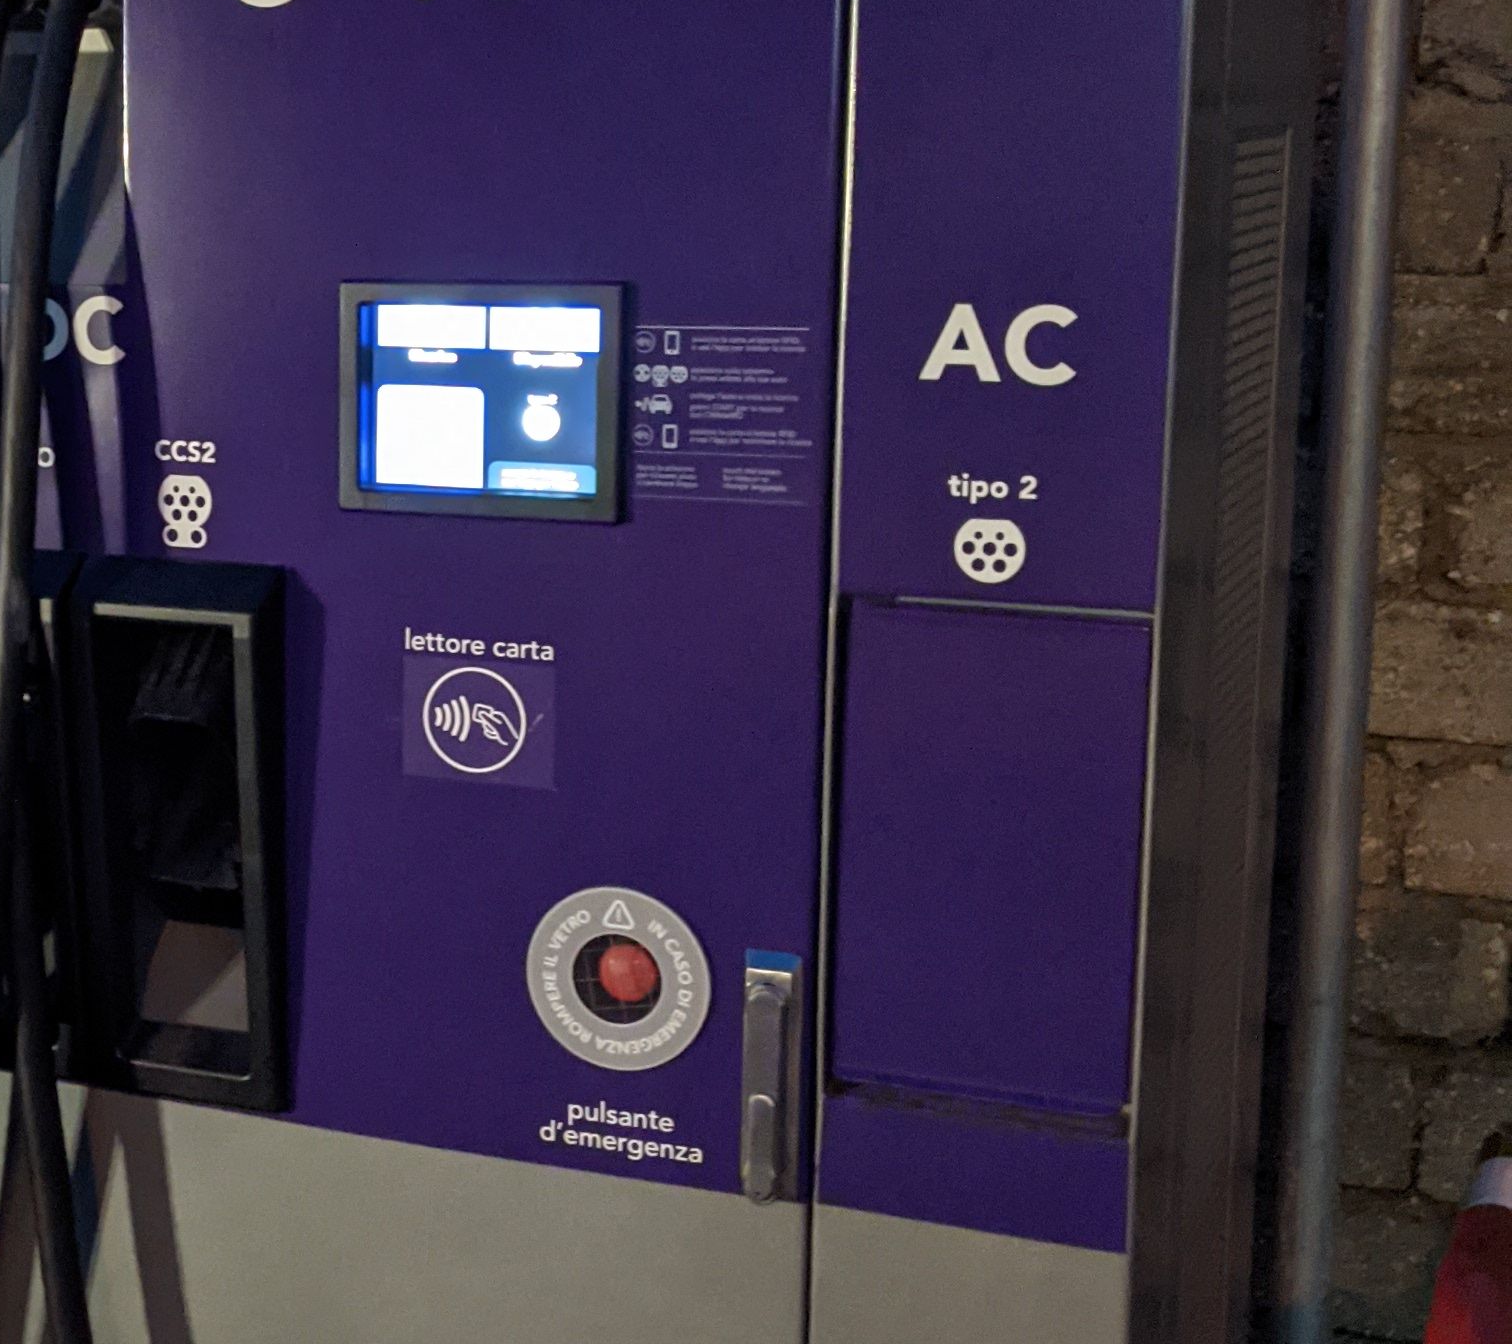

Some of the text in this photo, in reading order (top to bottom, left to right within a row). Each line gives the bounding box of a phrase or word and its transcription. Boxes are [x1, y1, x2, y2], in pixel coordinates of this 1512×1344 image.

[919, 304, 1078, 386] AC
[155, 439, 216, 463] CCS2
[947, 473, 1038, 504] tipo 2
[404, 627, 555, 661] lettore carta
[543, 910, 592, 1044] ROMPERE IL VETRO
[595, 919, 693, 1055] IN CASO DI EMERGENZA
[567, 1101, 675, 1133] pulsante
[539, 1120, 703, 1164] d'emergenza
